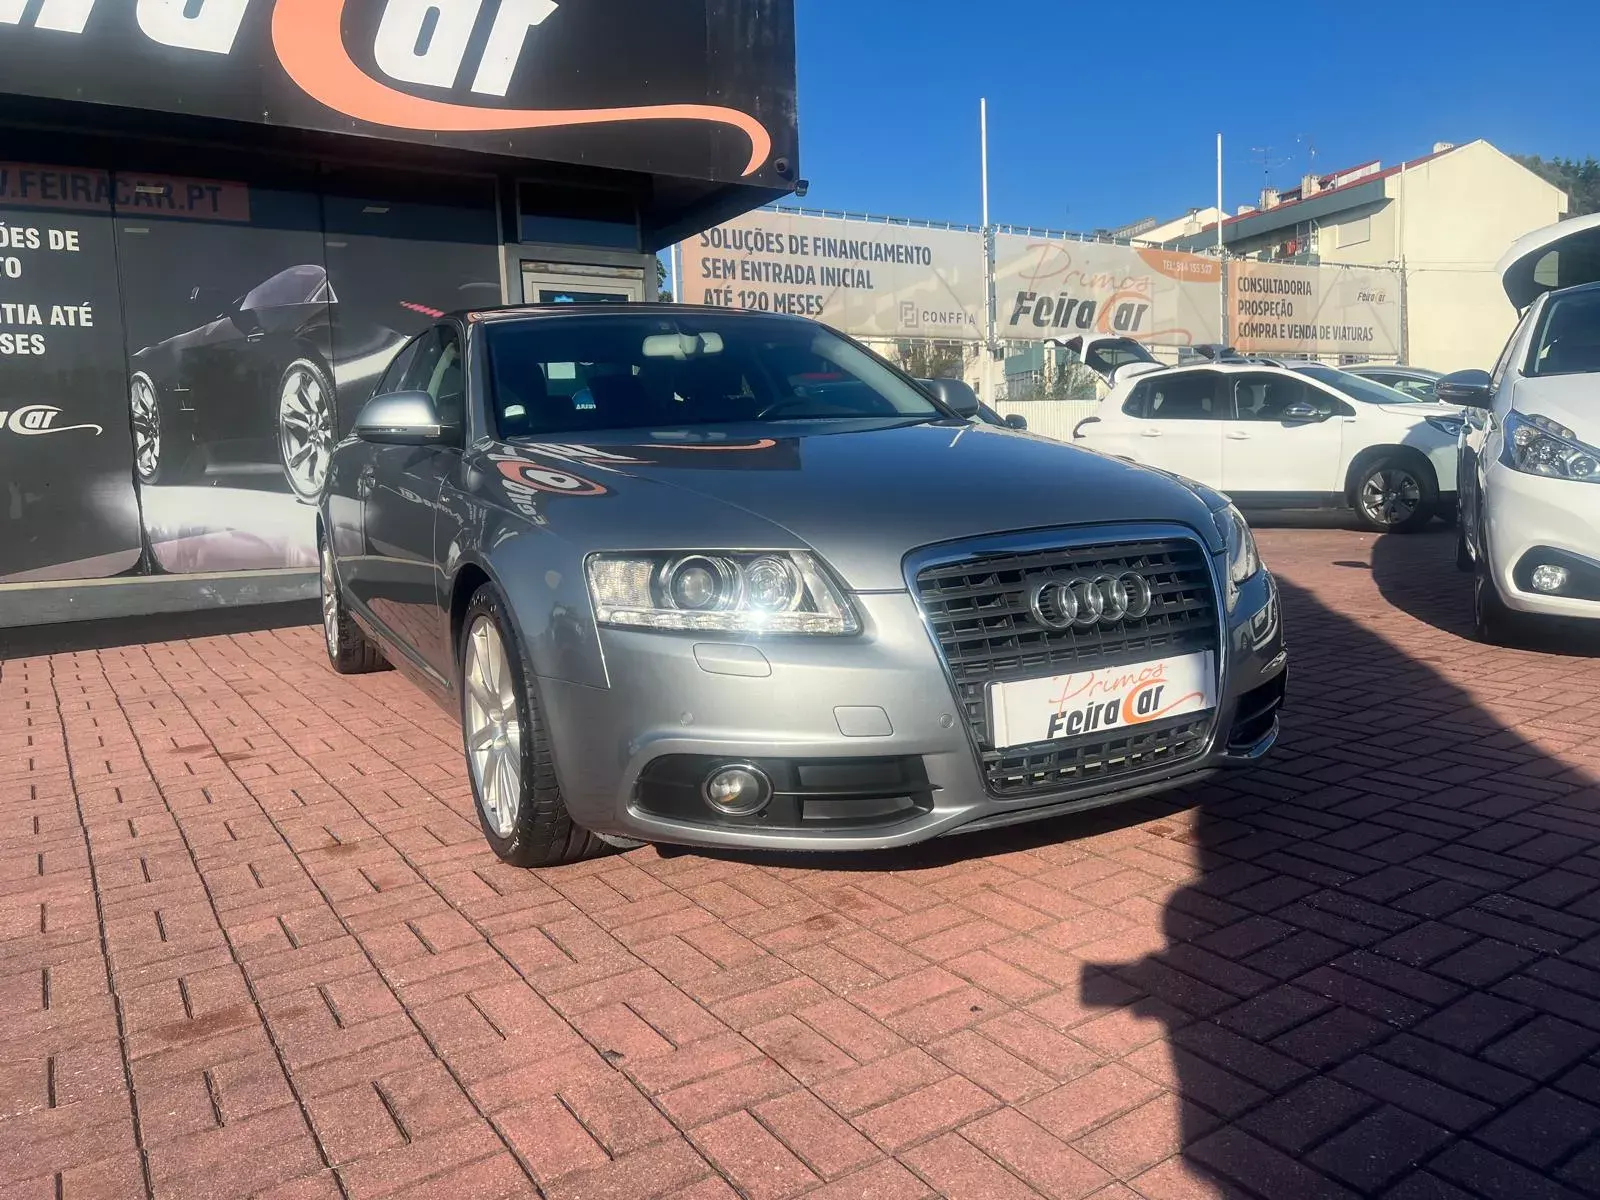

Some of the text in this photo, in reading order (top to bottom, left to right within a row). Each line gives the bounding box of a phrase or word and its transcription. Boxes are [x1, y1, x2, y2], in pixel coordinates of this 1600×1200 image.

[48, 229, 80, 251] DE
[700, 228, 932, 266] SOLUÇÕES DE FINANCIAMENTO
[701, 257, 874, 289] SEM ENTRADA INICIAL
[1018, 243, 1155, 297] Primos
[703, 285, 824, 315] ATÉ 120 MESES
[1237, 276, 1312, 296] CONSULTADORIA
[50, 301, 94, 327] ATÉ
[922, 310, 976, 325] CONFFIA
[1010, 290, 1153, 338] FeiraCar
[1237, 298, 1293, 320] PROSPEÇÃO
[1238, 322, 1374, 341] COMPRA E VENDA DE VIATURAS
[1049, 663, 1169, 719] Primos
[1047, 678, 1170, 739] FeiraCar
